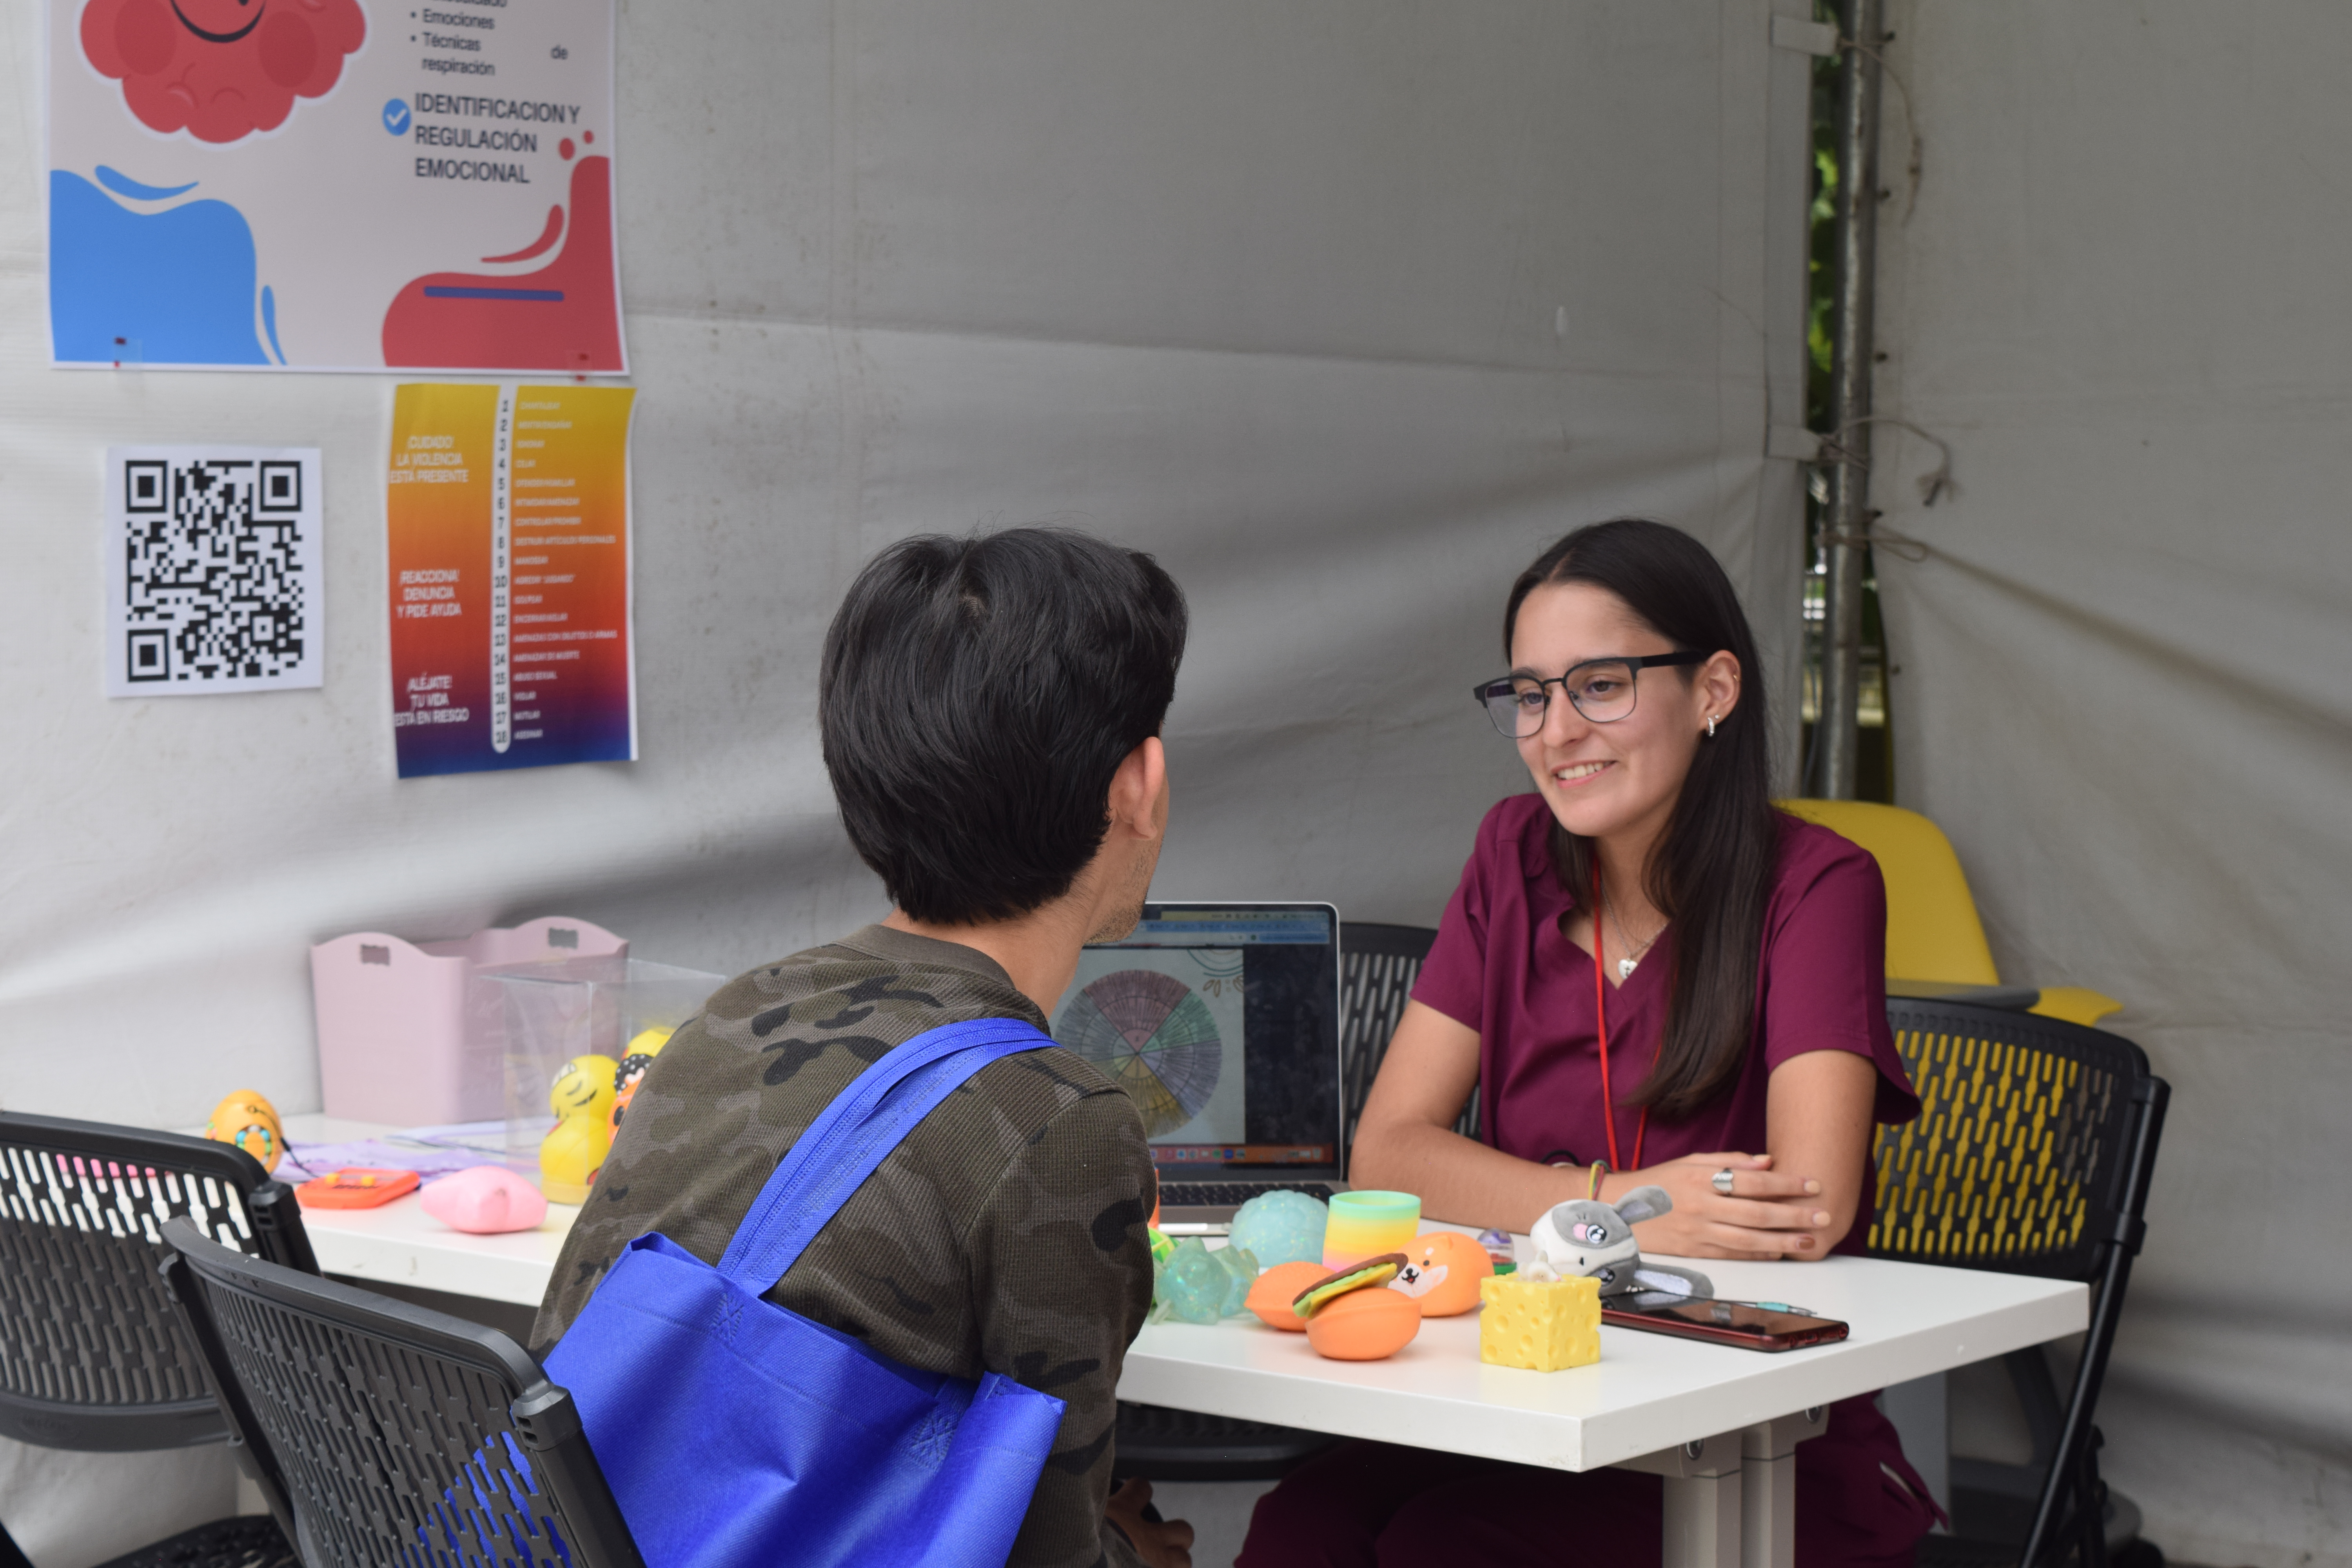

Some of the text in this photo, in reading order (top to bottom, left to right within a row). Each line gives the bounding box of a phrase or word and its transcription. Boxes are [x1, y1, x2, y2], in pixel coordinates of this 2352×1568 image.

[423, 9, 495, 29] Emociones
[422, 32, 568, 60] Técnicas de
[422, 57, 495, 76] respiración
[415, 93, 580, 123] IDENTIFICACION Y
[415, 125, 537, 152] REGULACIÓN
[415, 157, 530, 183] EMOCIONAL
[502, 400, 508, 412] 1
[501, 419, 507, 432] 2
[499, 439, 506, 451] 3
[396, 452, 463, 466] LA VIOLENCIA
[499, 458, 505, 470] 4
[416, 469, 470, 483] PRESENTE
[498, 478, 505, 490] 5
[498, 497, 504, 510] 6
[498, 517, 504, 529] 7
[498, 537, 504, 549] 8
[497, 555, 504, 568] 9
[495, 575, 506, 588] 10
[403, 585, 456, 601] DENUNCIA
[495, 595, 505, 607] 11
[396, 602, 463, 619] Y PIDE AYUDA
[495, 614, 505, 627] 12
[495, 634, 505, 646] 13
[495, 653, 505, 665] 14
[495, 673, 506, 685] 15
[409, 692, 450, 708] TU VIDA
[496, 692, 506, 704] 16
[416, 710, 431, 725] EN
[433, 707, 470, 724] RIESGO
[495, 711, 506, 724] 17
[496, 731, 506, 743] 18
